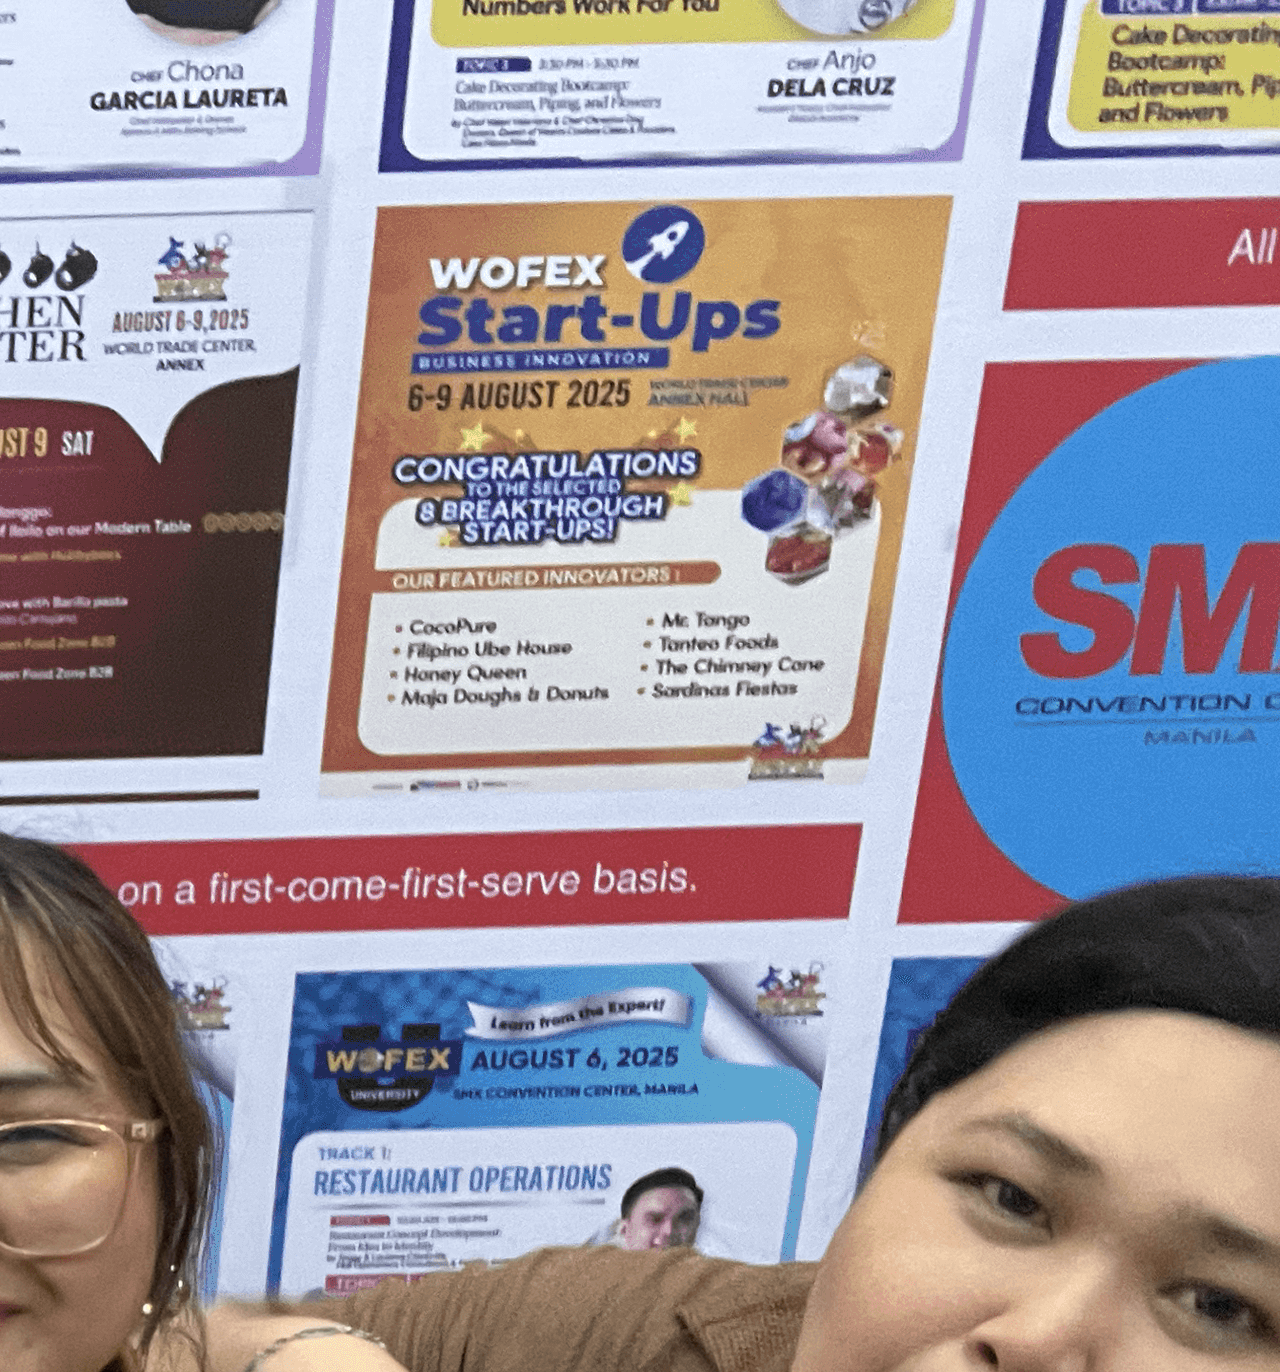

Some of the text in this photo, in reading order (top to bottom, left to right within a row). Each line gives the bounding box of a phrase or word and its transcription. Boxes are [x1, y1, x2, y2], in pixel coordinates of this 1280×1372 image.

[167, 60, 244, 82] Chona
[823, 47, 876, 74] Anjo
[90, 87, 288, 111] GARCIA LAURETA
[767, 76, 897, 98] DELA CRUZ
[1227, 227, 1278, 267] All
[429, 254, 607, 290] WOFEX
[112, 310, 173, 333] AUGUST
[417, 291, 781, 353] Start-Ups
[102, 341, 154, 355] WORLD
[155, 340, 199, 354] TRADE
[155, 358, 206, 372] ANNEX
[418, 351, 651, 371] BUSINESS INNOVATION
[408, 383, 452, 412] 6-9
[460, 380, 558, 411] AUGUST
[566, 377, 631, 409] 2025
[33, 427, 49, 458] 9
[60, 430, 95, 456] SAT
[394, 451, 698, 483] CONGRATULATIONS
[466, 478, 622, 497] TO THE SELECTED
[441, 496, 663, 522] BREAKTHROUGH
[463, 518, 614, 543] START-UPS!
[393, 573, 436, 589] OUR
[440, 570, 540, 589] FEATURED
[1019, 541, 1280, 680] SM
[407, 640, 574, 661] Filipino Ube House
[404, 666, 527, 685] Honey Queen
[655, 658, 688, 676] The
[693, 657, 773, 677] Chimney
[1015, 693, 1251, 715] CONVENTION
[1144, 728, 1257, 745] MANILA
[117, 861, 698, 907] on a first-come-first-serve basis.
[490, 1015, 536, 1032] Learn
[578, 1005, 605, 1021] the
[470, 1045, 680, 1072] AUGUST 6, 2025
[318, 1146, 376, 1162] TRACK
[314, 1163, 612, 1197] RESTAURANT OPERATIONS
